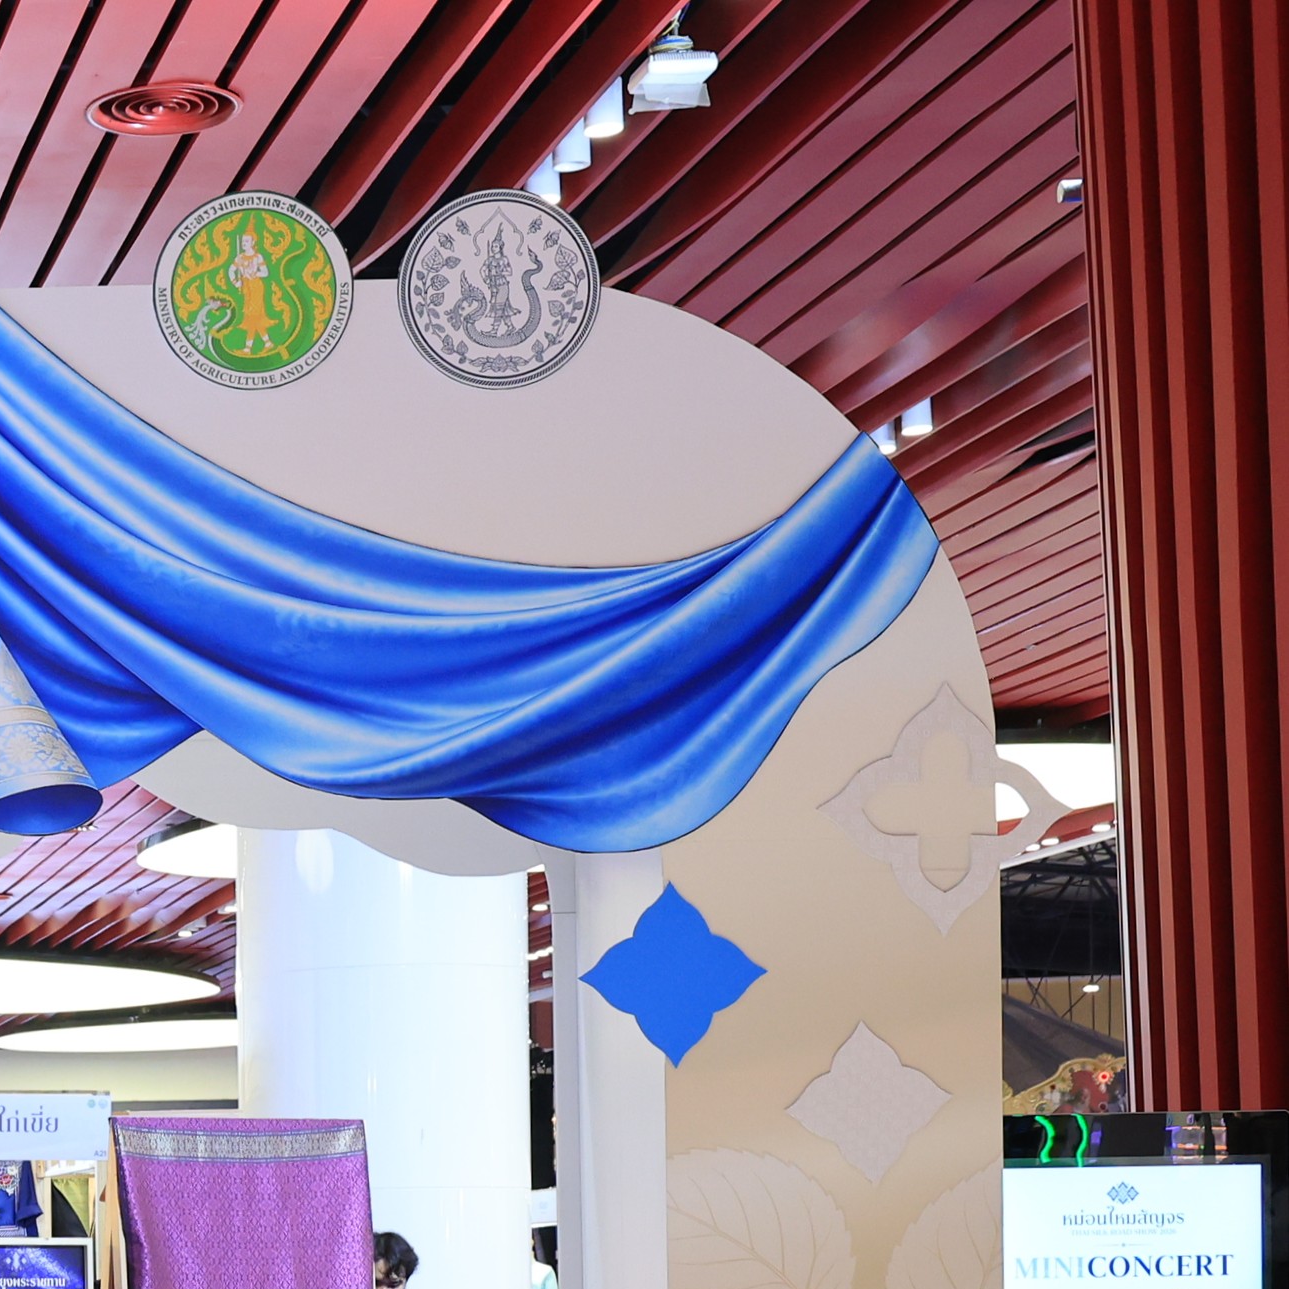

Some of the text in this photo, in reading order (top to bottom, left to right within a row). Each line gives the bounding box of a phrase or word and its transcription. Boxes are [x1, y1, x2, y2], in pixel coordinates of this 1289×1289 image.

[177, 195, 332, 241] กระทรวงเกษตรและสหกรณ์
[157, 281, 350, 387] MINISTRY OF AGRICULTURE AND COOPERATIVES
[1062, 1205, 1185, 1228] หม่อนไหมสัญจร
